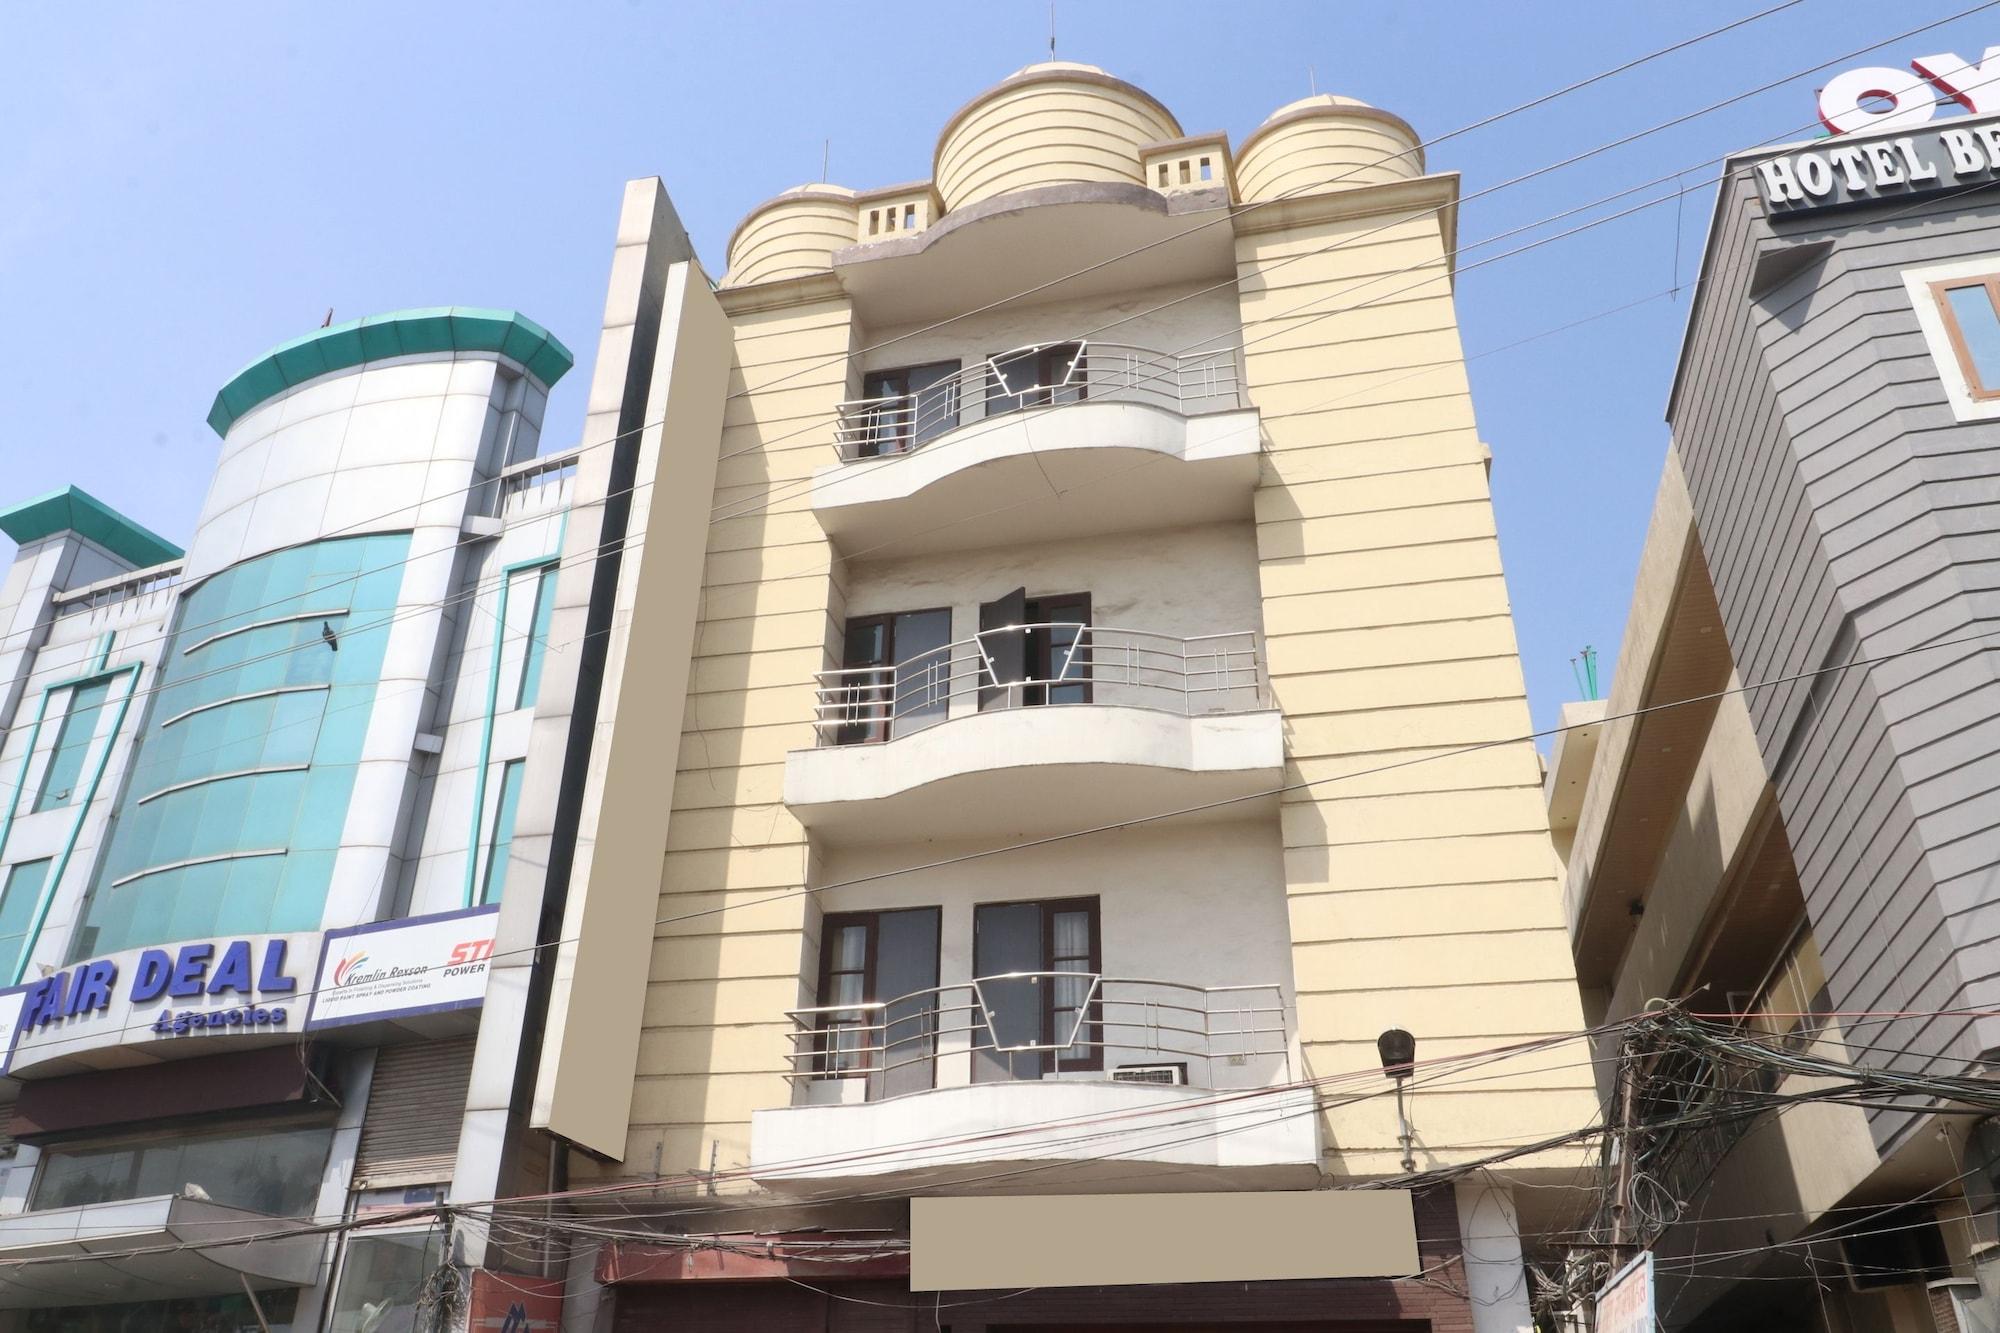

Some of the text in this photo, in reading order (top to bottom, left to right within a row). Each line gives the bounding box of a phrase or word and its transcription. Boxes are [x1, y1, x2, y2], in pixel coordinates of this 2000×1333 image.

[1757, 137, 1937, 203] HOTEL
[345, 965, 428, 986] Kremlin Rexson
[443, 963, 486, 978] POWER
[21, 939, 297, 1031] FAIR DEAL
[150, 1006, 287, 1034] Agencies
